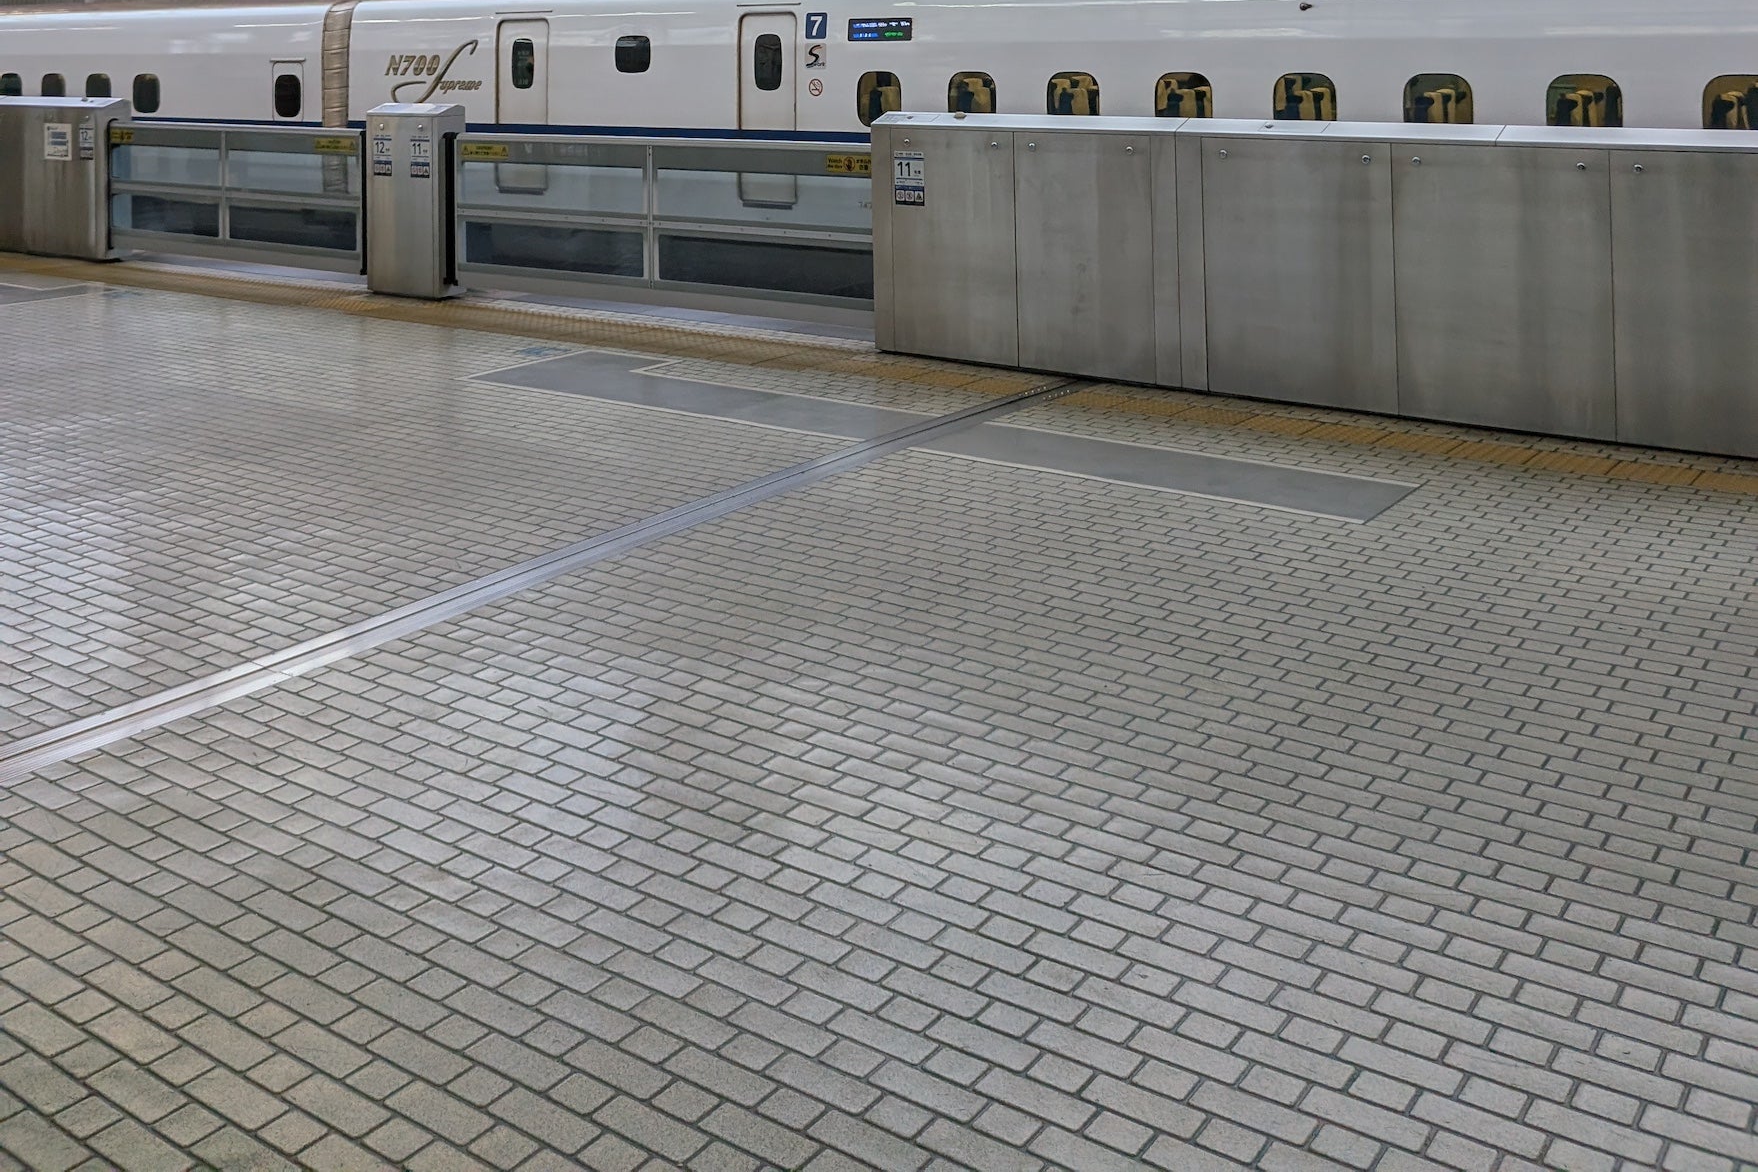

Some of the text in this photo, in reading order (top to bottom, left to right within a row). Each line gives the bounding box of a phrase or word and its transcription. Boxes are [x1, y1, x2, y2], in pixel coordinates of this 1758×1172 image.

[810, 15, 823, 37] 7
[384, 54, 441, 76] N700
[375, 141, 385, 154] 12
[412, 143, 422, 155] 11
[897, 161, 911, 177] 11
